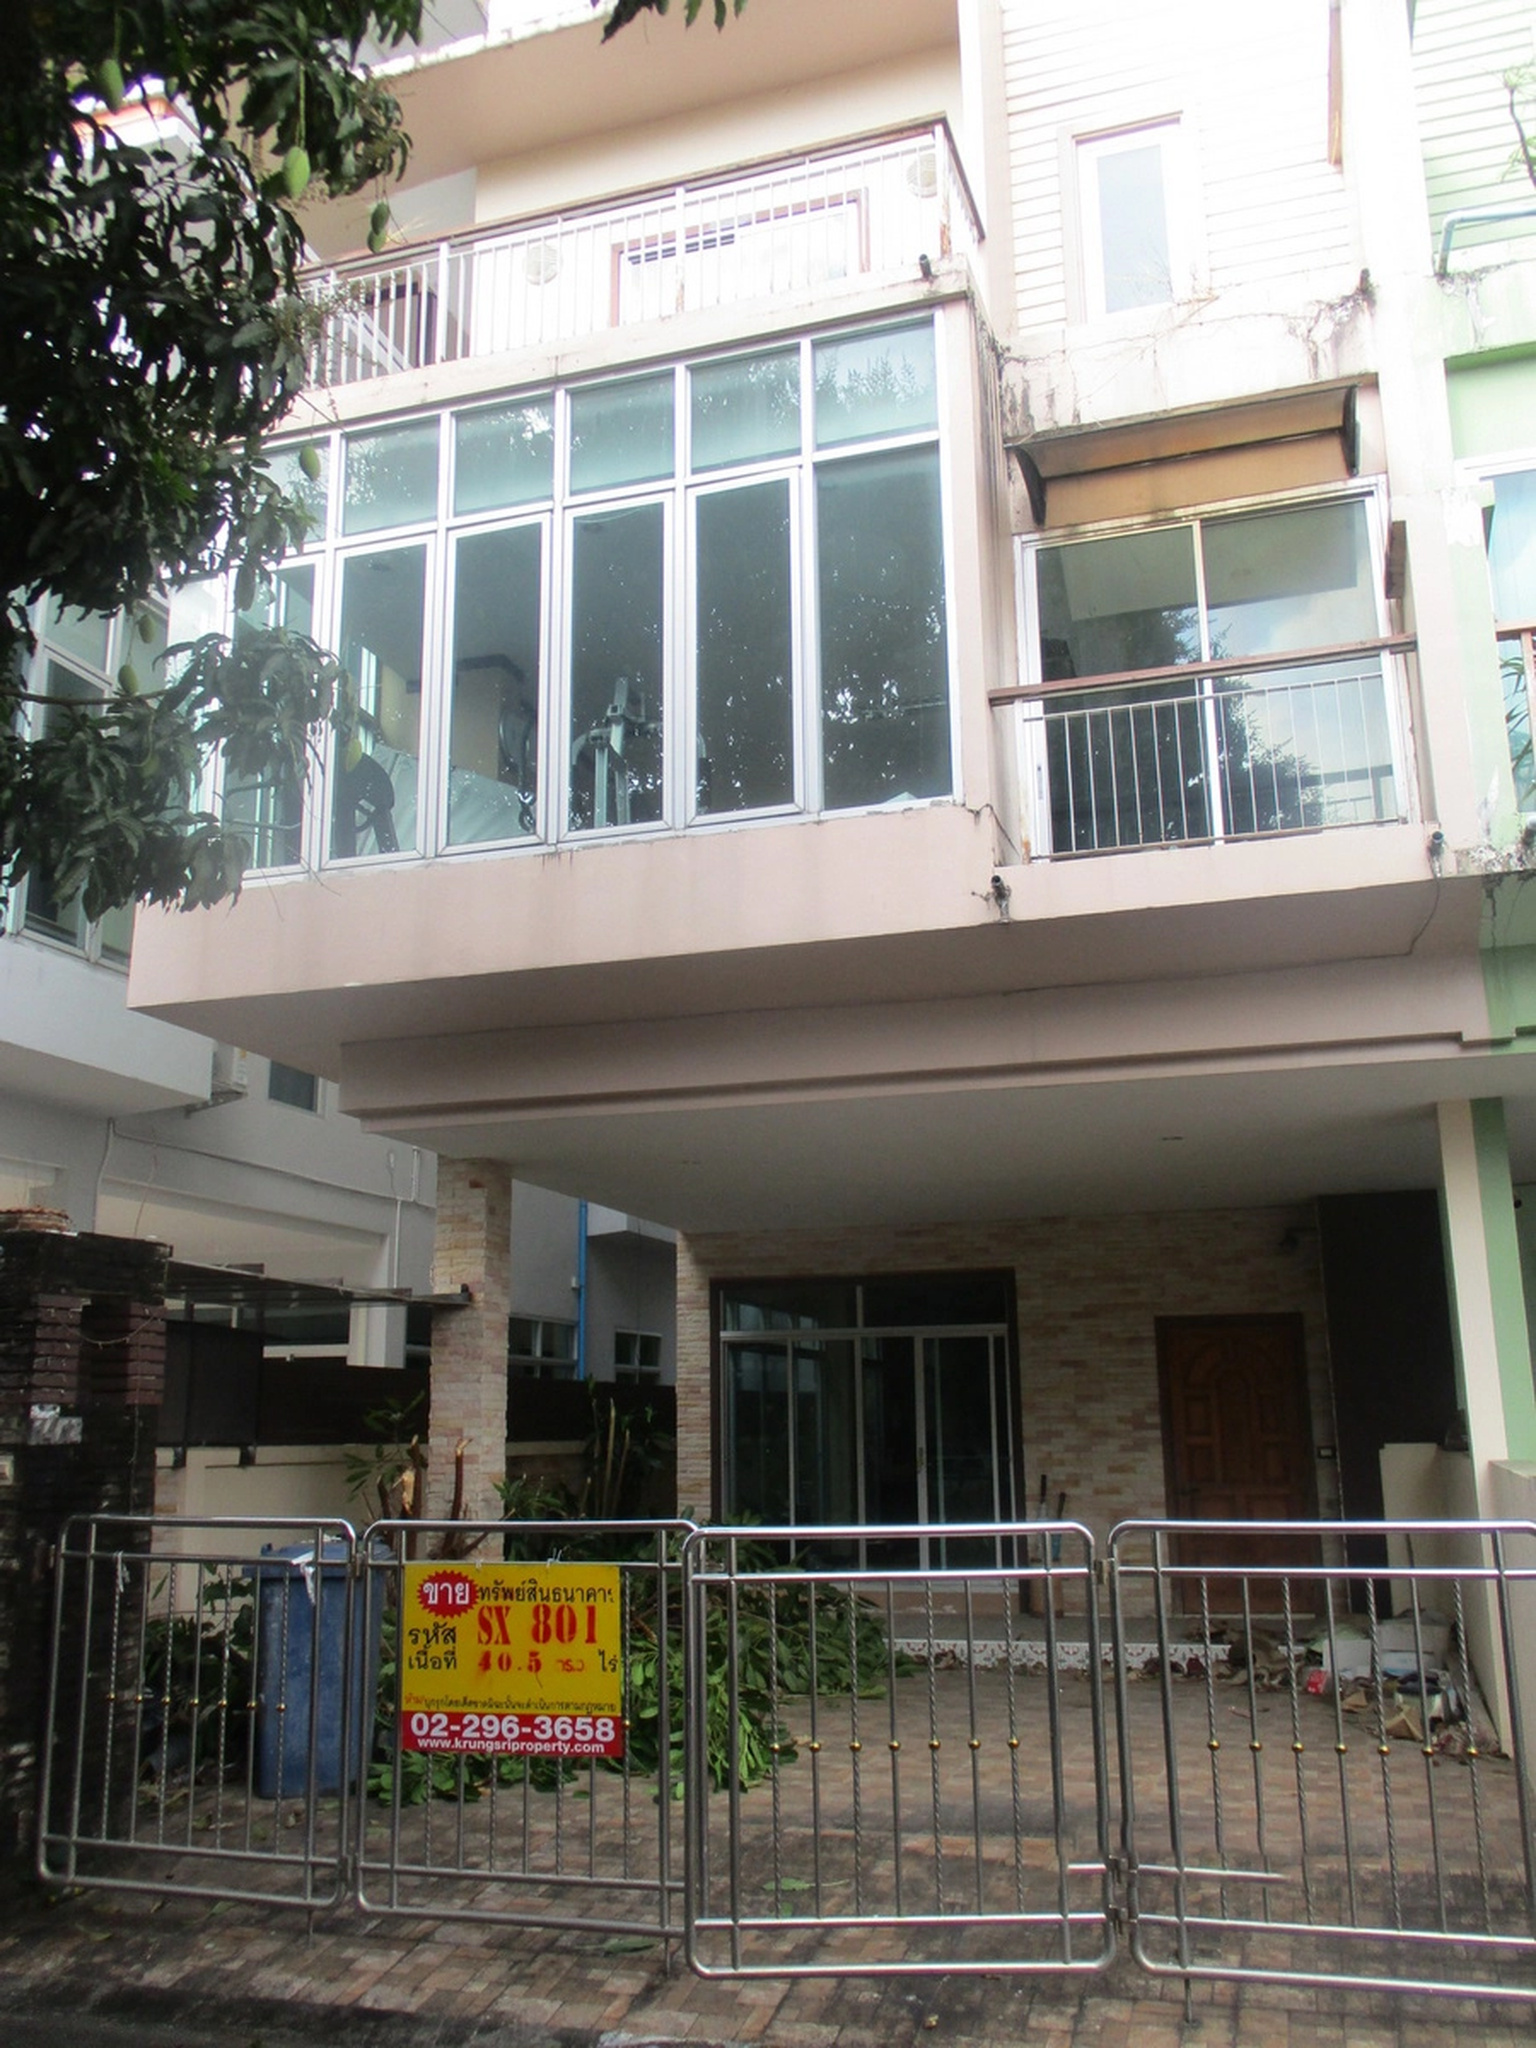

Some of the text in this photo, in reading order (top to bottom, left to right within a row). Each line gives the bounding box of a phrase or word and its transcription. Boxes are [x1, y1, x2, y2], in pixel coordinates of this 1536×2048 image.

[423, 1582, 470, 1605] ขาย
[408, 1603, 598, 1645] รหัส SX 801
[408, 1643, 457, 1671] เนื้อที่
[598, 1649, 619, 1673] ไร่
[410, 1712, 616, 1742] 02-296-3658
[417, 1737, 605, 1754] www.krungsriproperty.com
